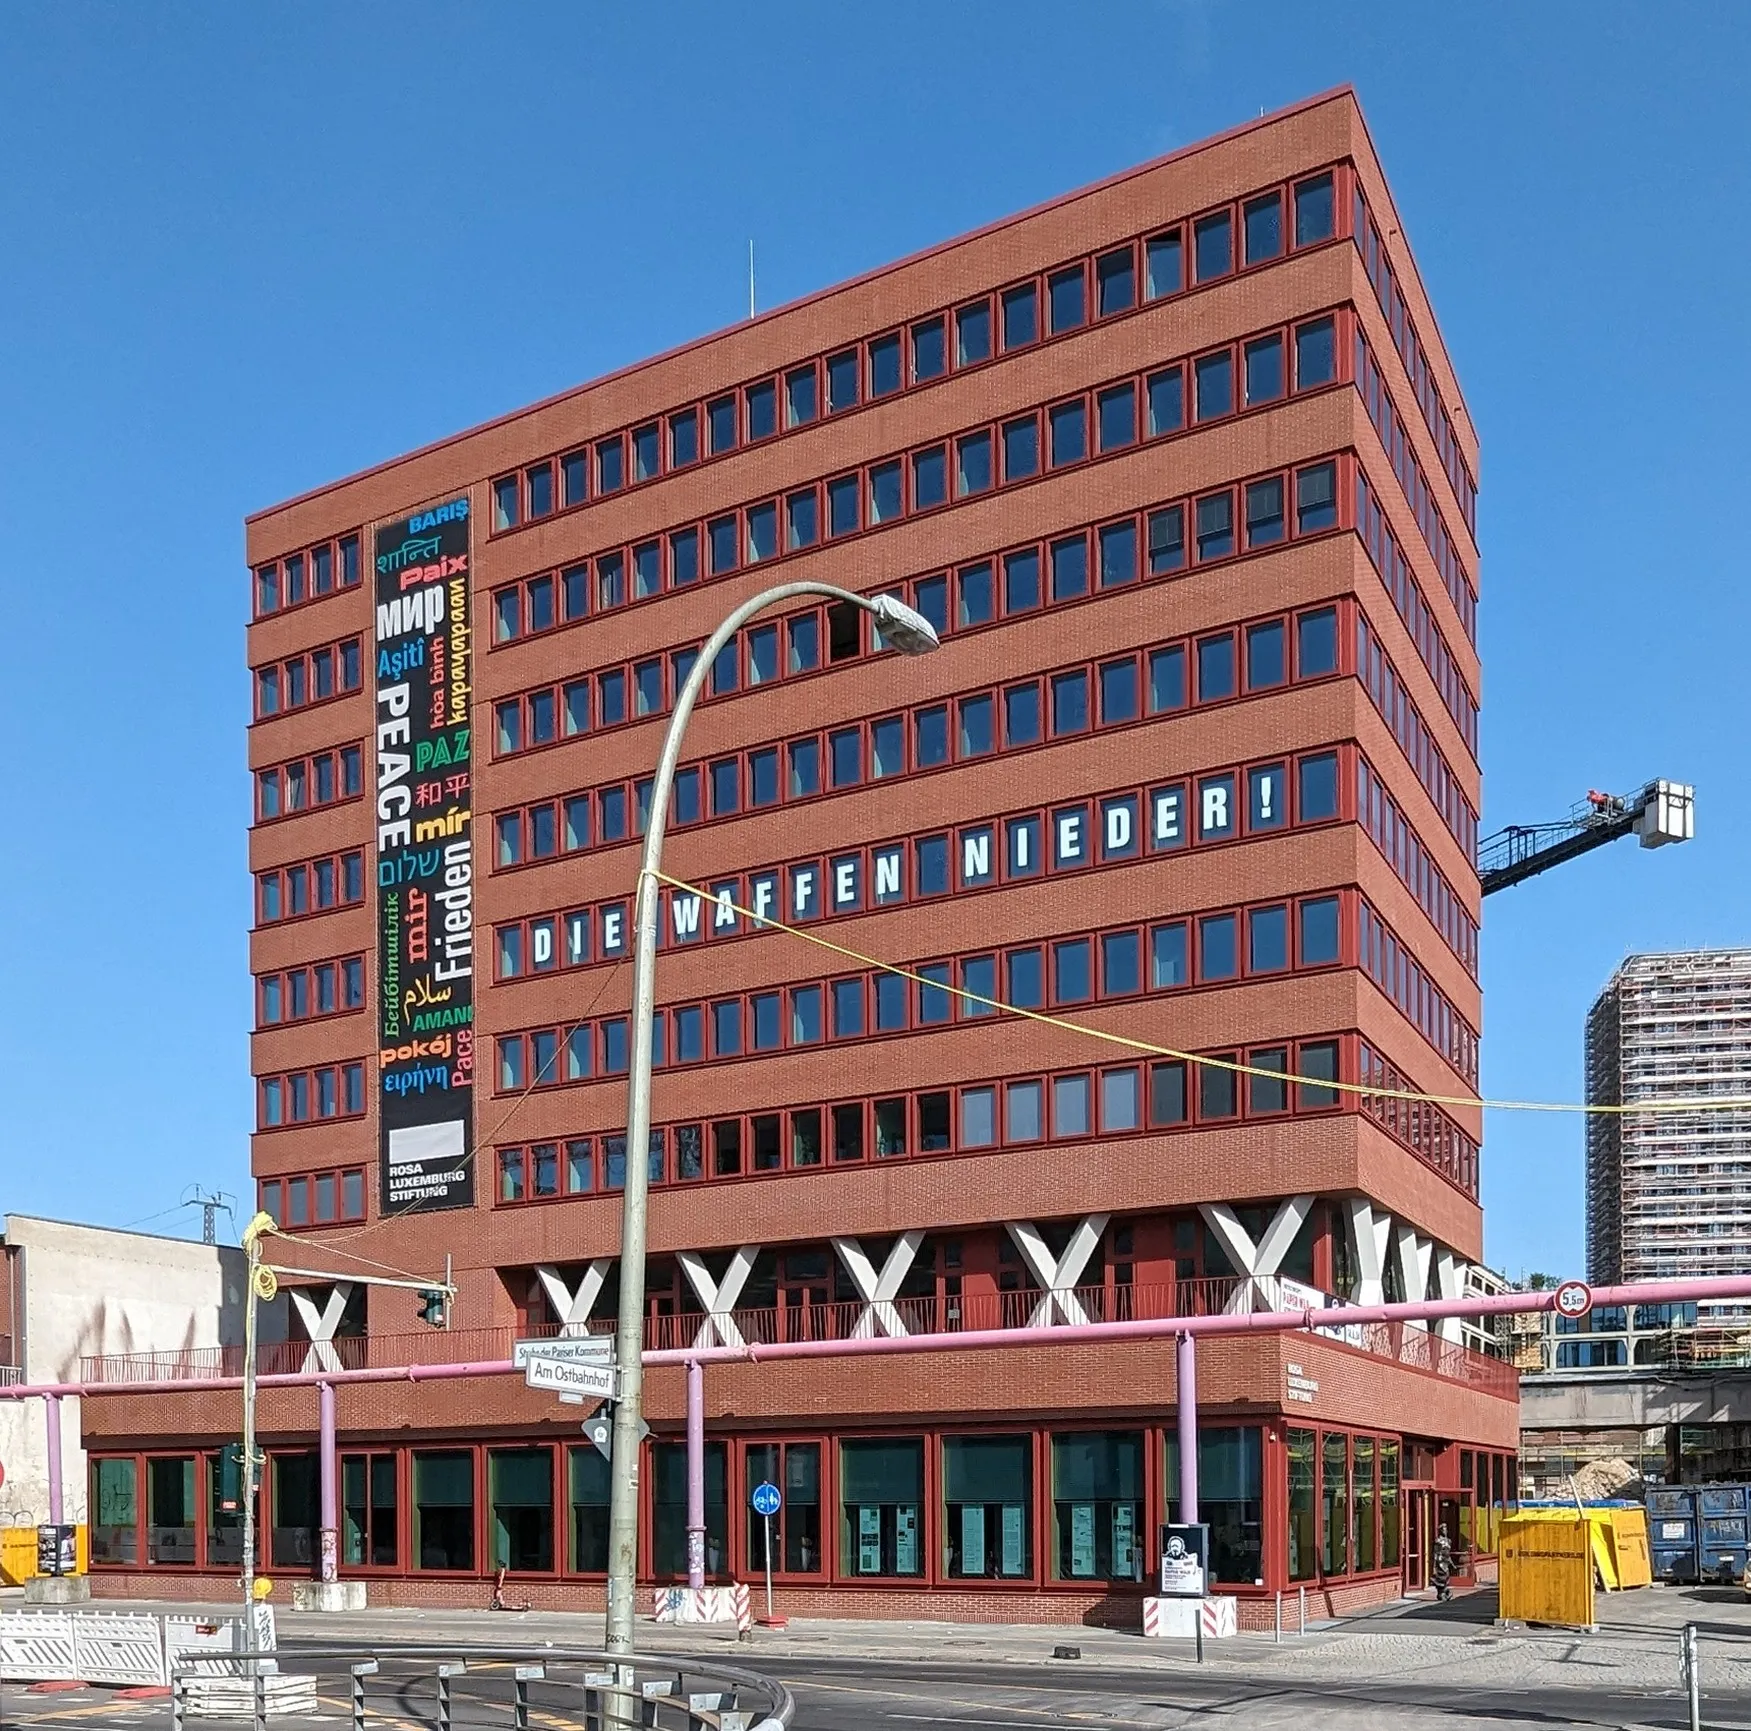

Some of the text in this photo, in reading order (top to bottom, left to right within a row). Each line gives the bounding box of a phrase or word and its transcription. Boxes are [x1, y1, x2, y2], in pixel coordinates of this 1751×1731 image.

[409, 499, 469, 534] BARIŞ
[377, 536, 442, 574] शान्ति
[400, 554, 468, 591] Paix
[378, 637, 425, 681] Aşitî
[447, 577, 471, 726] kapayapaan
[378, 682, 411, 852] PEACE
[416, 729, 470, 773] PAZ
[415, 773, 470, 809] 和平
[416, 806, 471, 843] mír
[379, 849, 439, 887] שלום
[534, 776, 1272, 963] DIE WAFFEN NIEDER!
[404, 888, 427, 963] mir
[435, 840, 472, 982] Frieden
[384, 892, 399, 1037] Бейбітшілік
[404, 973, 451, 1026] سلام
[412, 1004, 473, 1032] AMANI
[380, 1033, 451, 1068] pokój
[451, 1029, 472, 1087] Pace
[385, 1062, 448, 1097] ειρήνη
[389, 1163, 423, 1177] ROSA
[389, 1170, 465, 1189] LUXEMBURG
[389, 1185, 448, 1202] STIFTUNG
[552, 1346, 574, 1358] Pariser
[534, 1362, 610, 1388] Am Ostbahnhof
